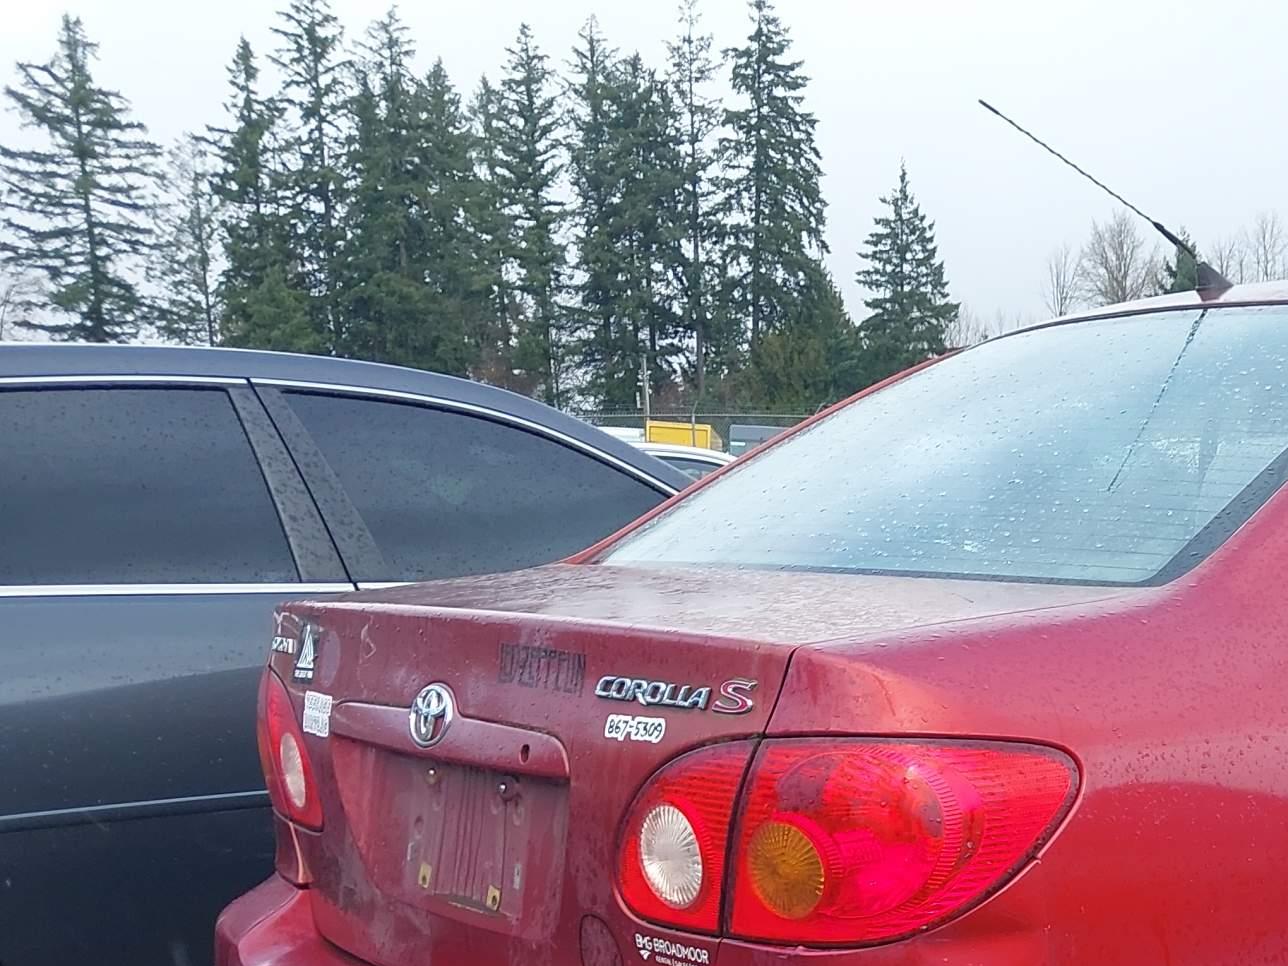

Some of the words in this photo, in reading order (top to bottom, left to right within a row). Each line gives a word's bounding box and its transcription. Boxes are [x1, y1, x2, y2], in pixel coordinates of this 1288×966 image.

[594, 676, 712, 710] COROLLA
[711, 678, 759, 714] S
[607, 717, 665, 741] 867-5309
[653, 938, 710, 965] BROADMOOR
